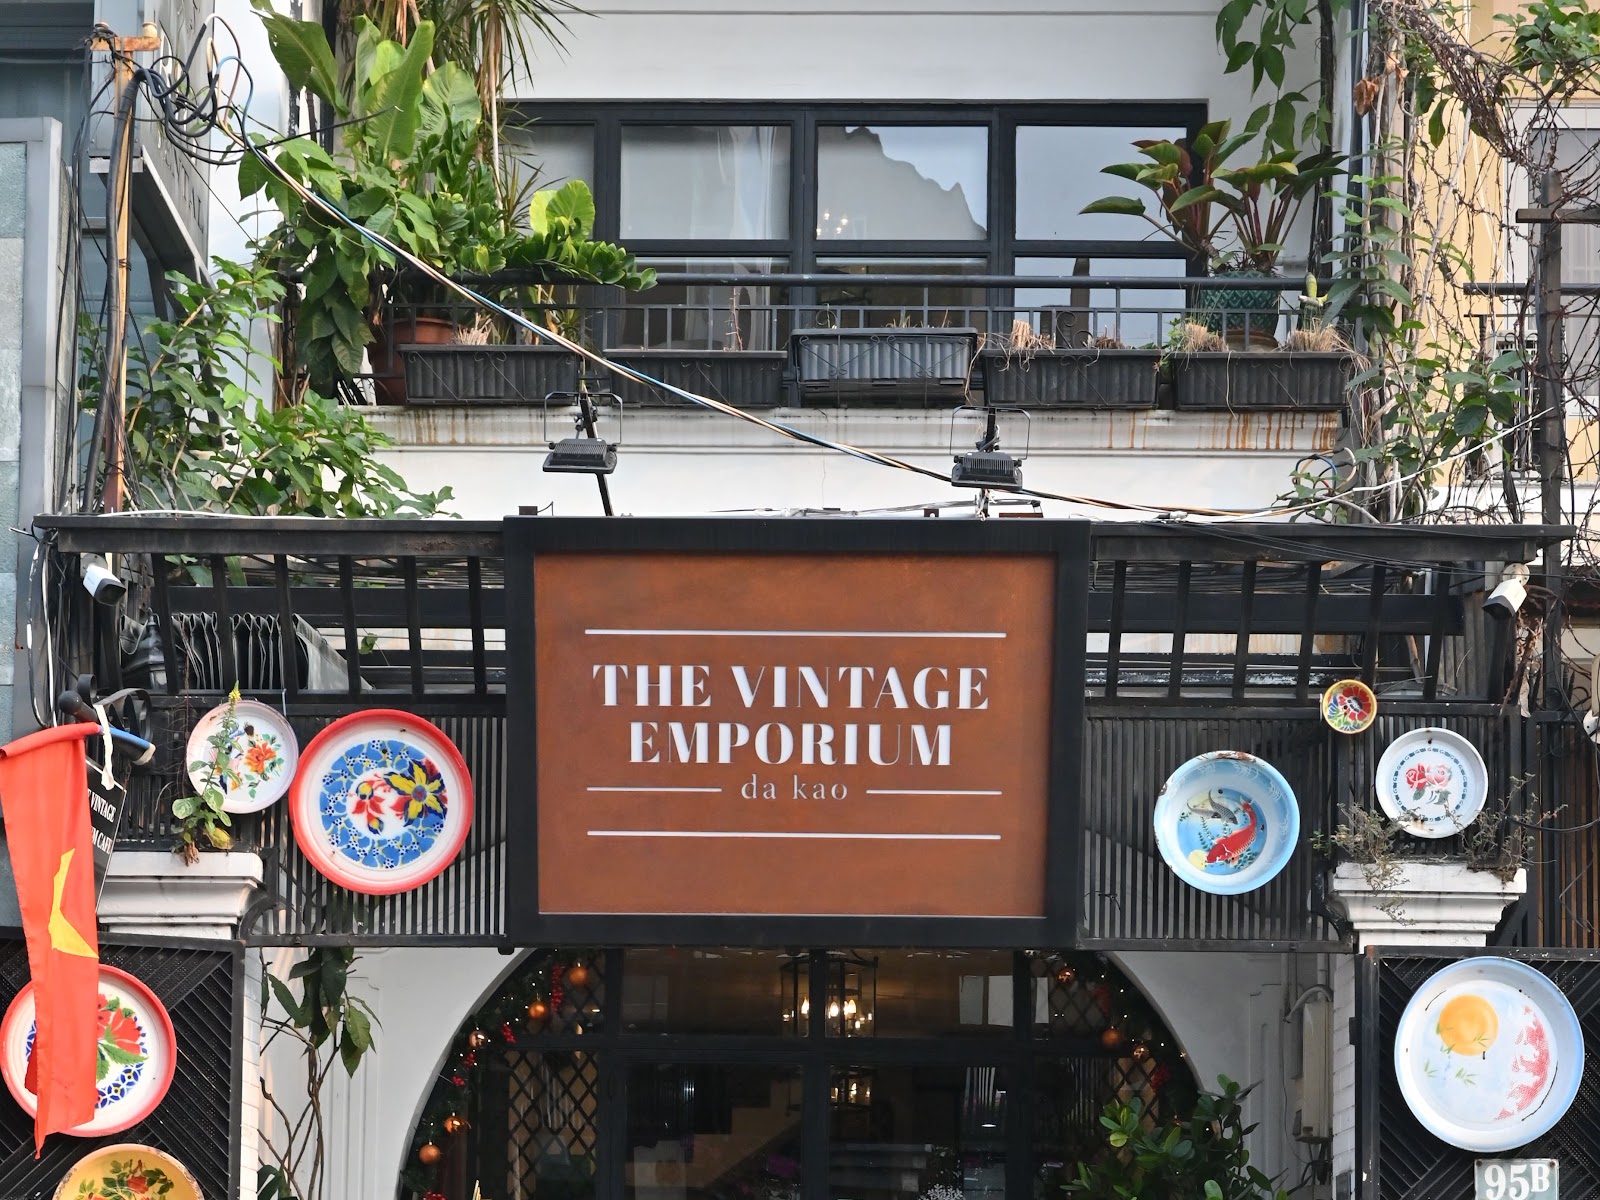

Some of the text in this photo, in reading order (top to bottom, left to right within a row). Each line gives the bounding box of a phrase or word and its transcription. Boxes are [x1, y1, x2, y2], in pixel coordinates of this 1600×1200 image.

[592, 664, 989, 710] THE VINTAGE
[628, 721, 952, 767] EMPORIUM
[740, 774, 848, 801] da kao
[91, 792, 117, 823] VINTAGE
[1484, 1163, 1550, 1200] 95B
